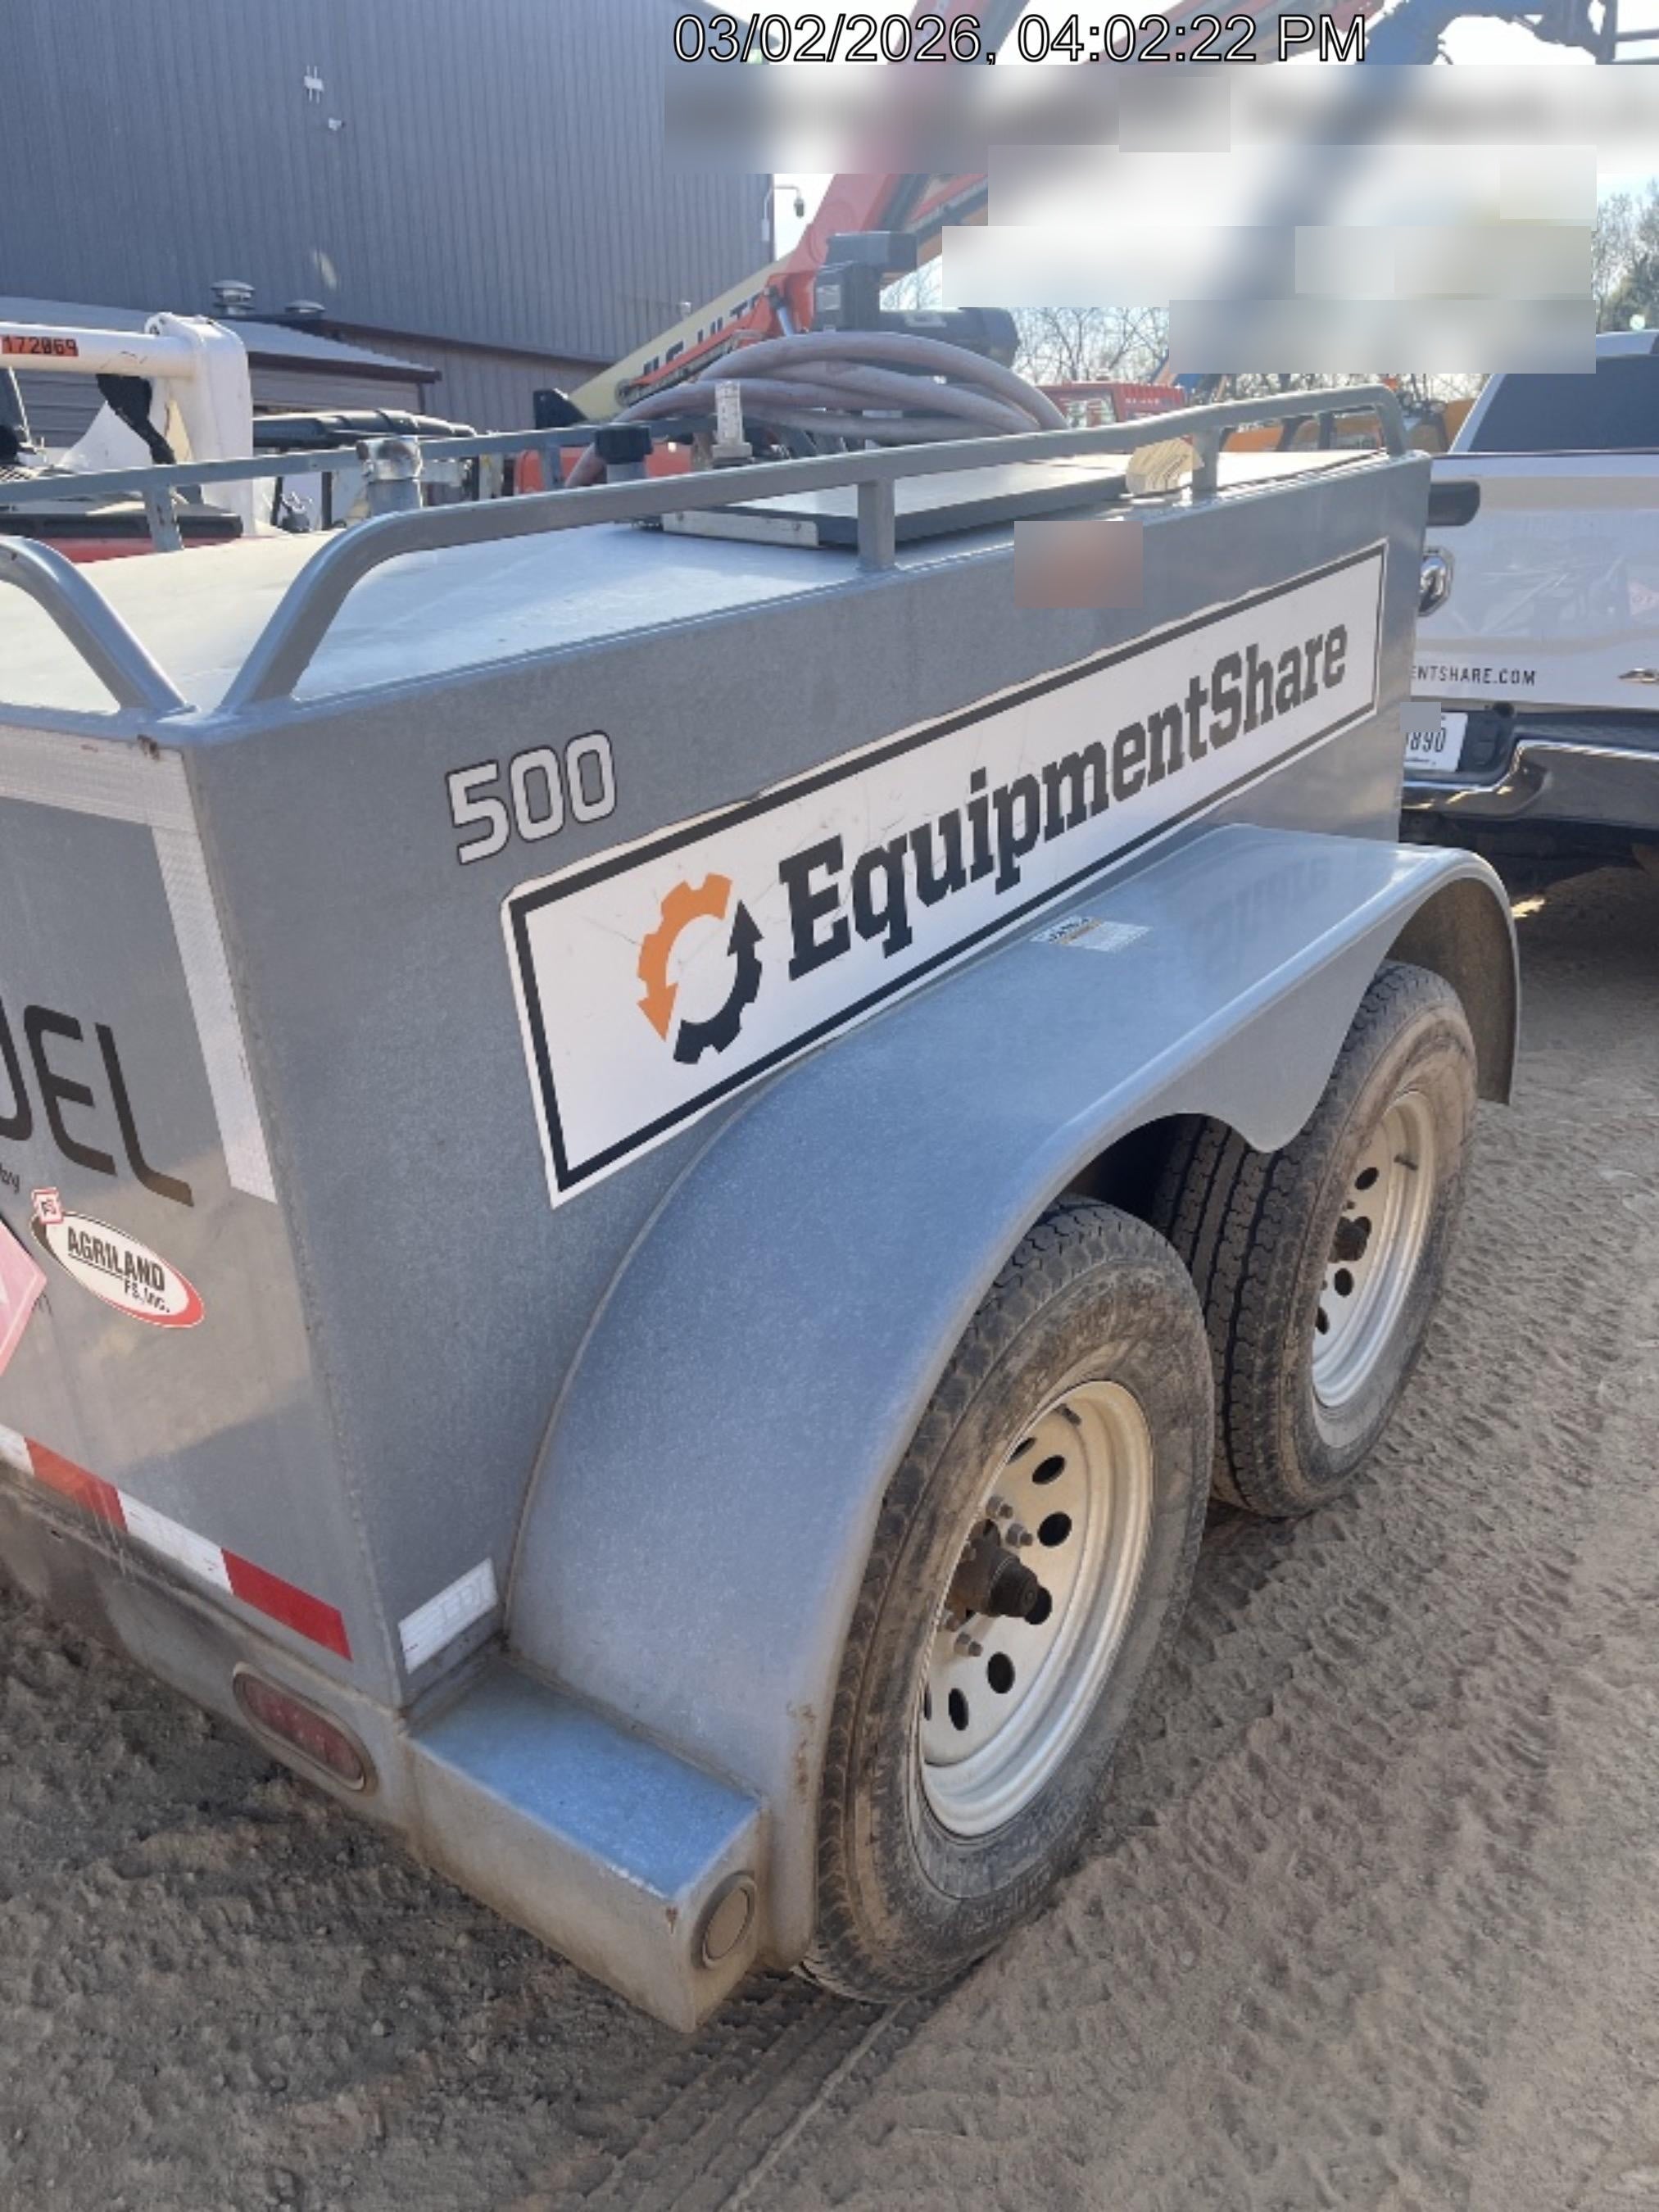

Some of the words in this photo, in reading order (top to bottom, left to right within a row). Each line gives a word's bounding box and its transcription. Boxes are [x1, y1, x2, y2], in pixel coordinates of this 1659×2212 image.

[2, 335, 79, 356] 172069
[446, 729, 617, 865] 500
[778, 624, 1348, 981] EquipmentShare
[68, 1226, 165, 1291] AGRILAND
